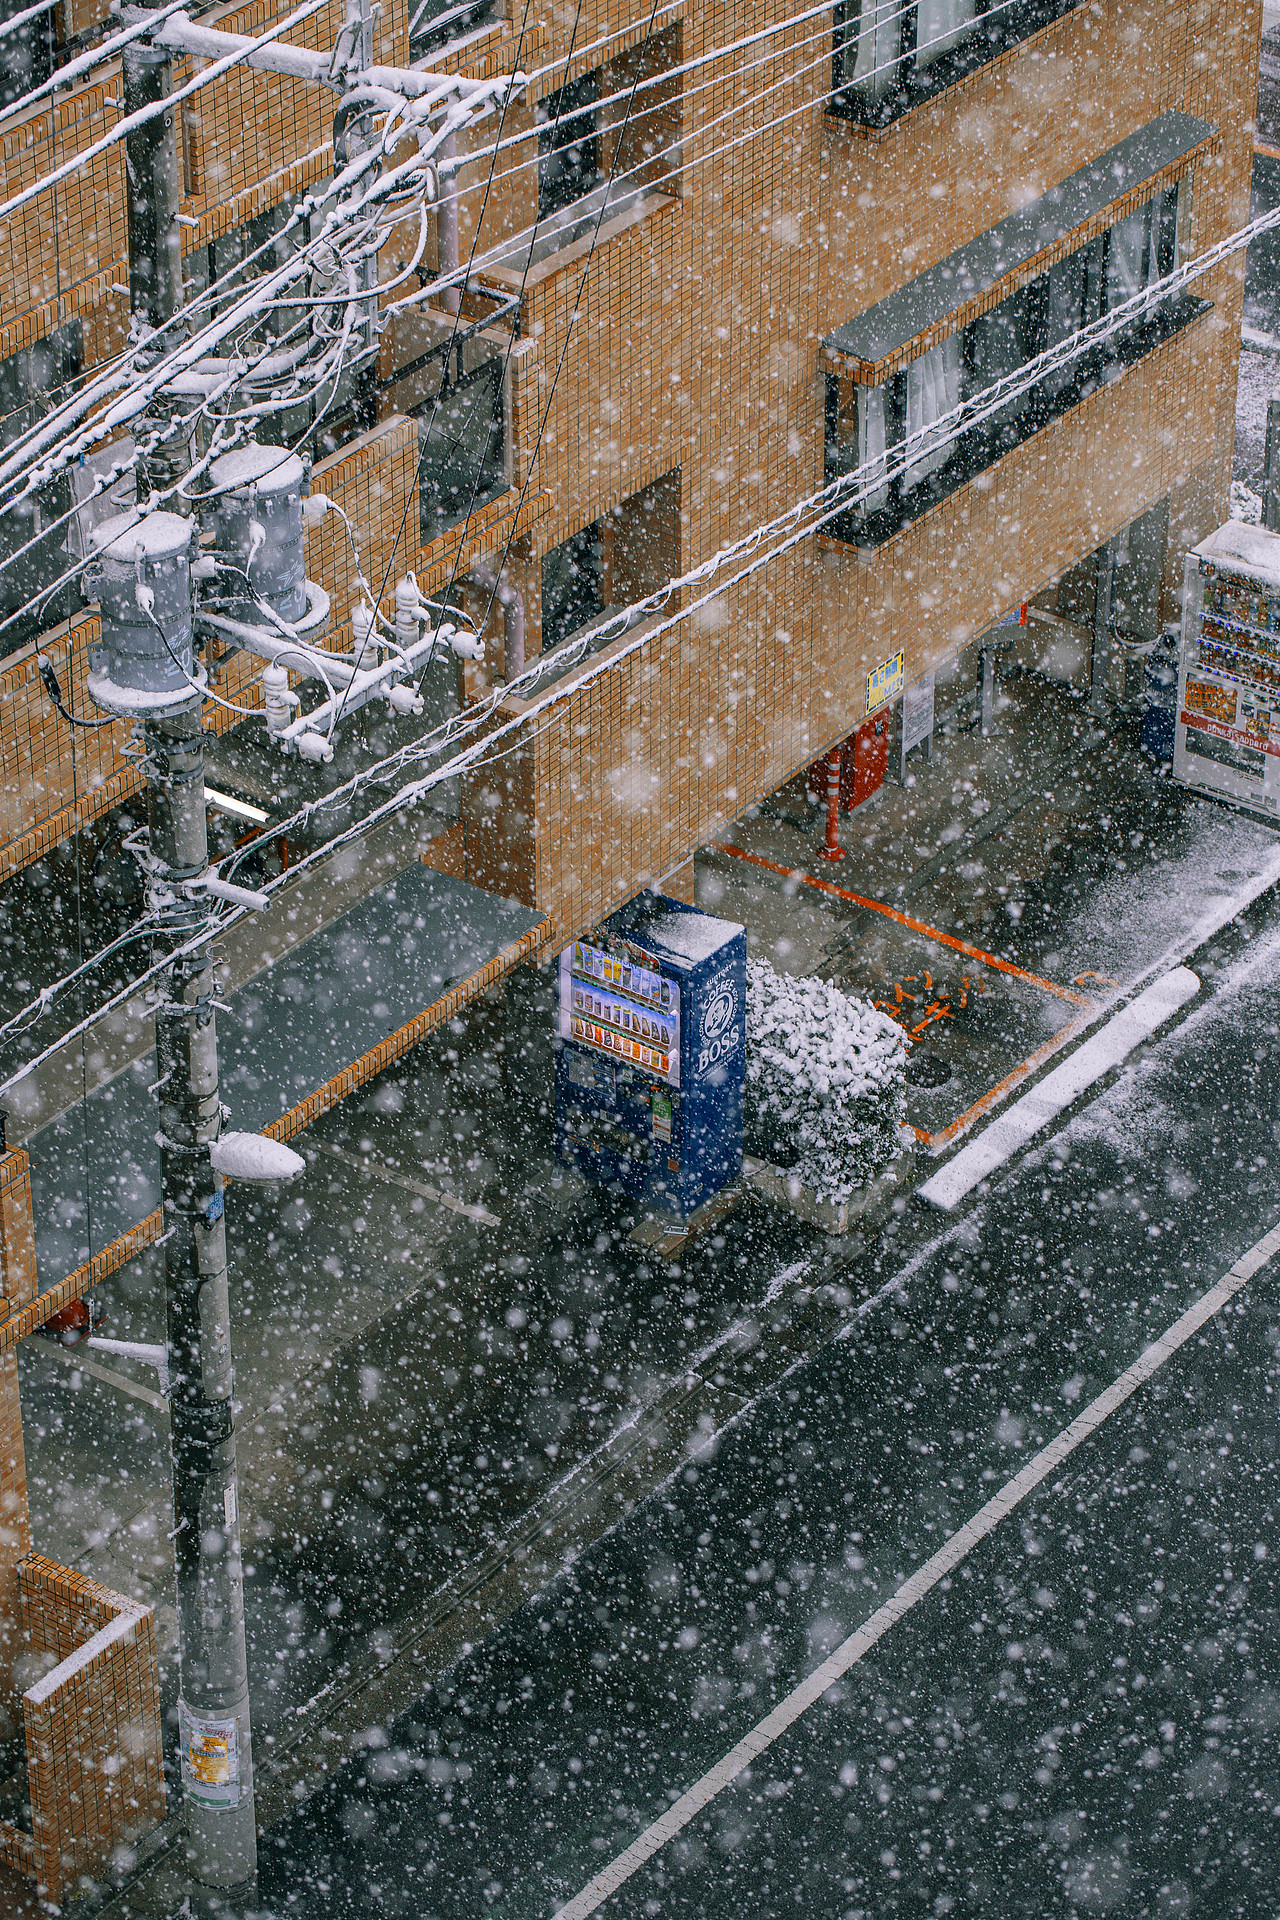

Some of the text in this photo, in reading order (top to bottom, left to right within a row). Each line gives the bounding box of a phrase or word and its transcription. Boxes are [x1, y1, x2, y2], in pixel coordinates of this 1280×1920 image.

[706, 963, 733, 988] SUNTORY
[704, 979, 735, 1009] COFFEE
[698, 1025, 739, 1073] BOSS
